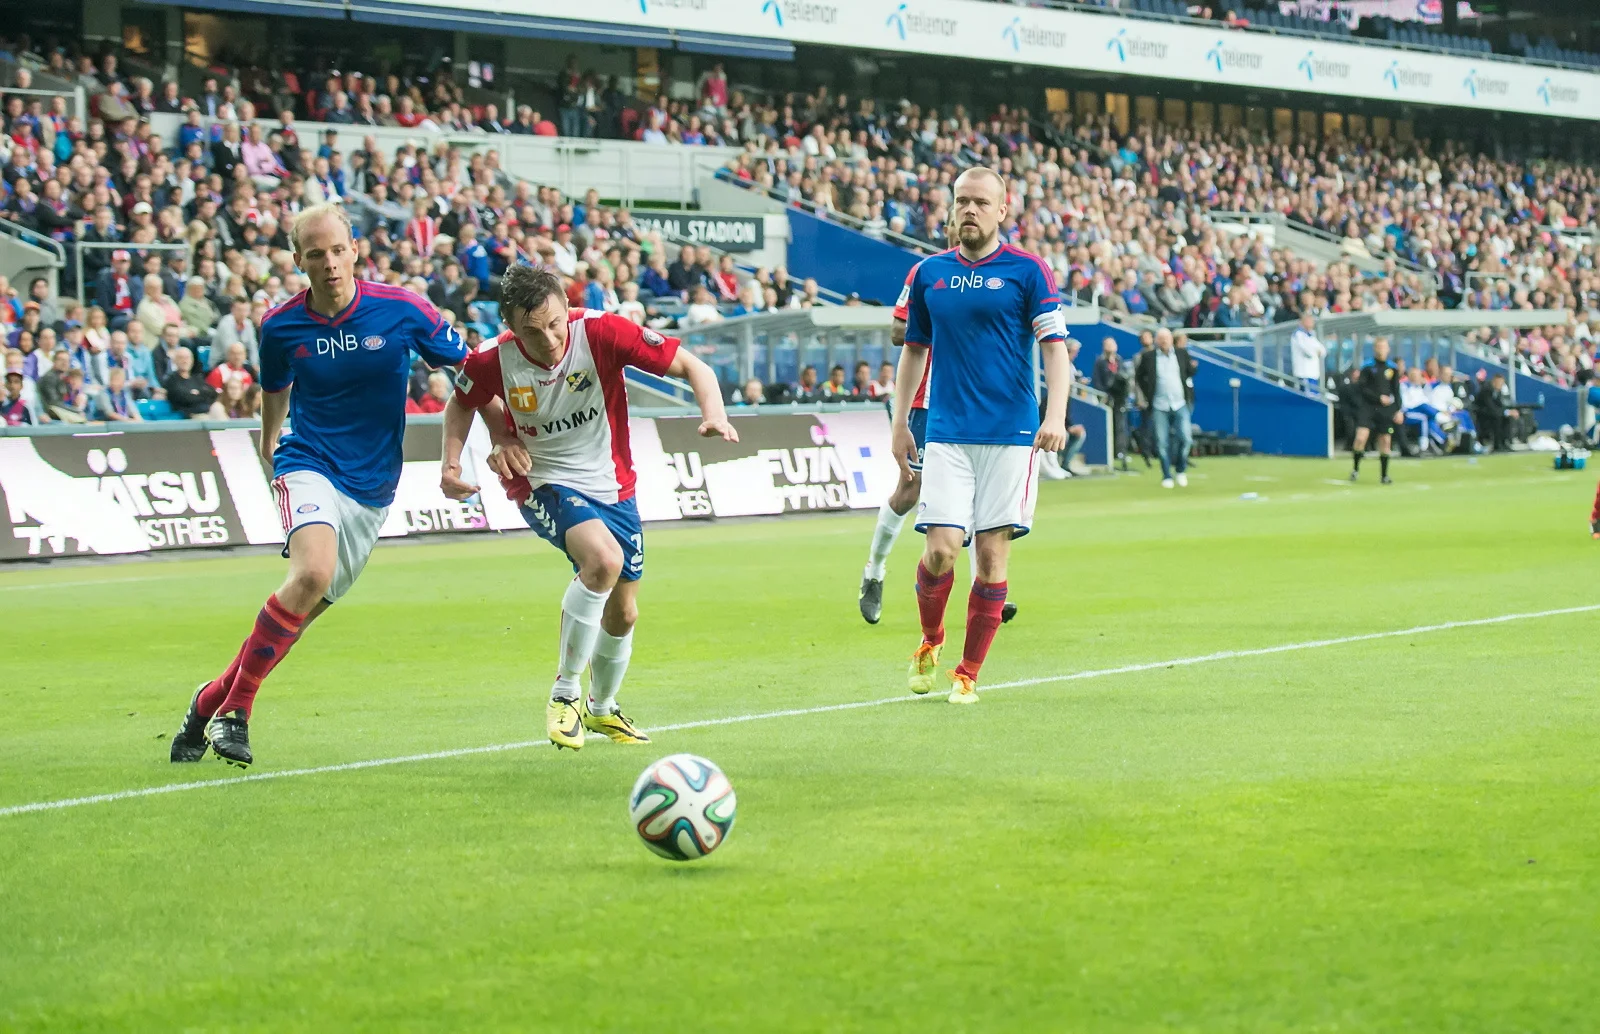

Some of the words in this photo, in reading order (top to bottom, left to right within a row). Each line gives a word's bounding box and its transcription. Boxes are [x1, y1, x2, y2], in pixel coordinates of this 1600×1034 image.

[687, 219, 756, 244] STADION
[950, 271, 983, 293] DNB
[316, 329, 358, 359] DNB
[541, 406, 599, 434] VISMA
